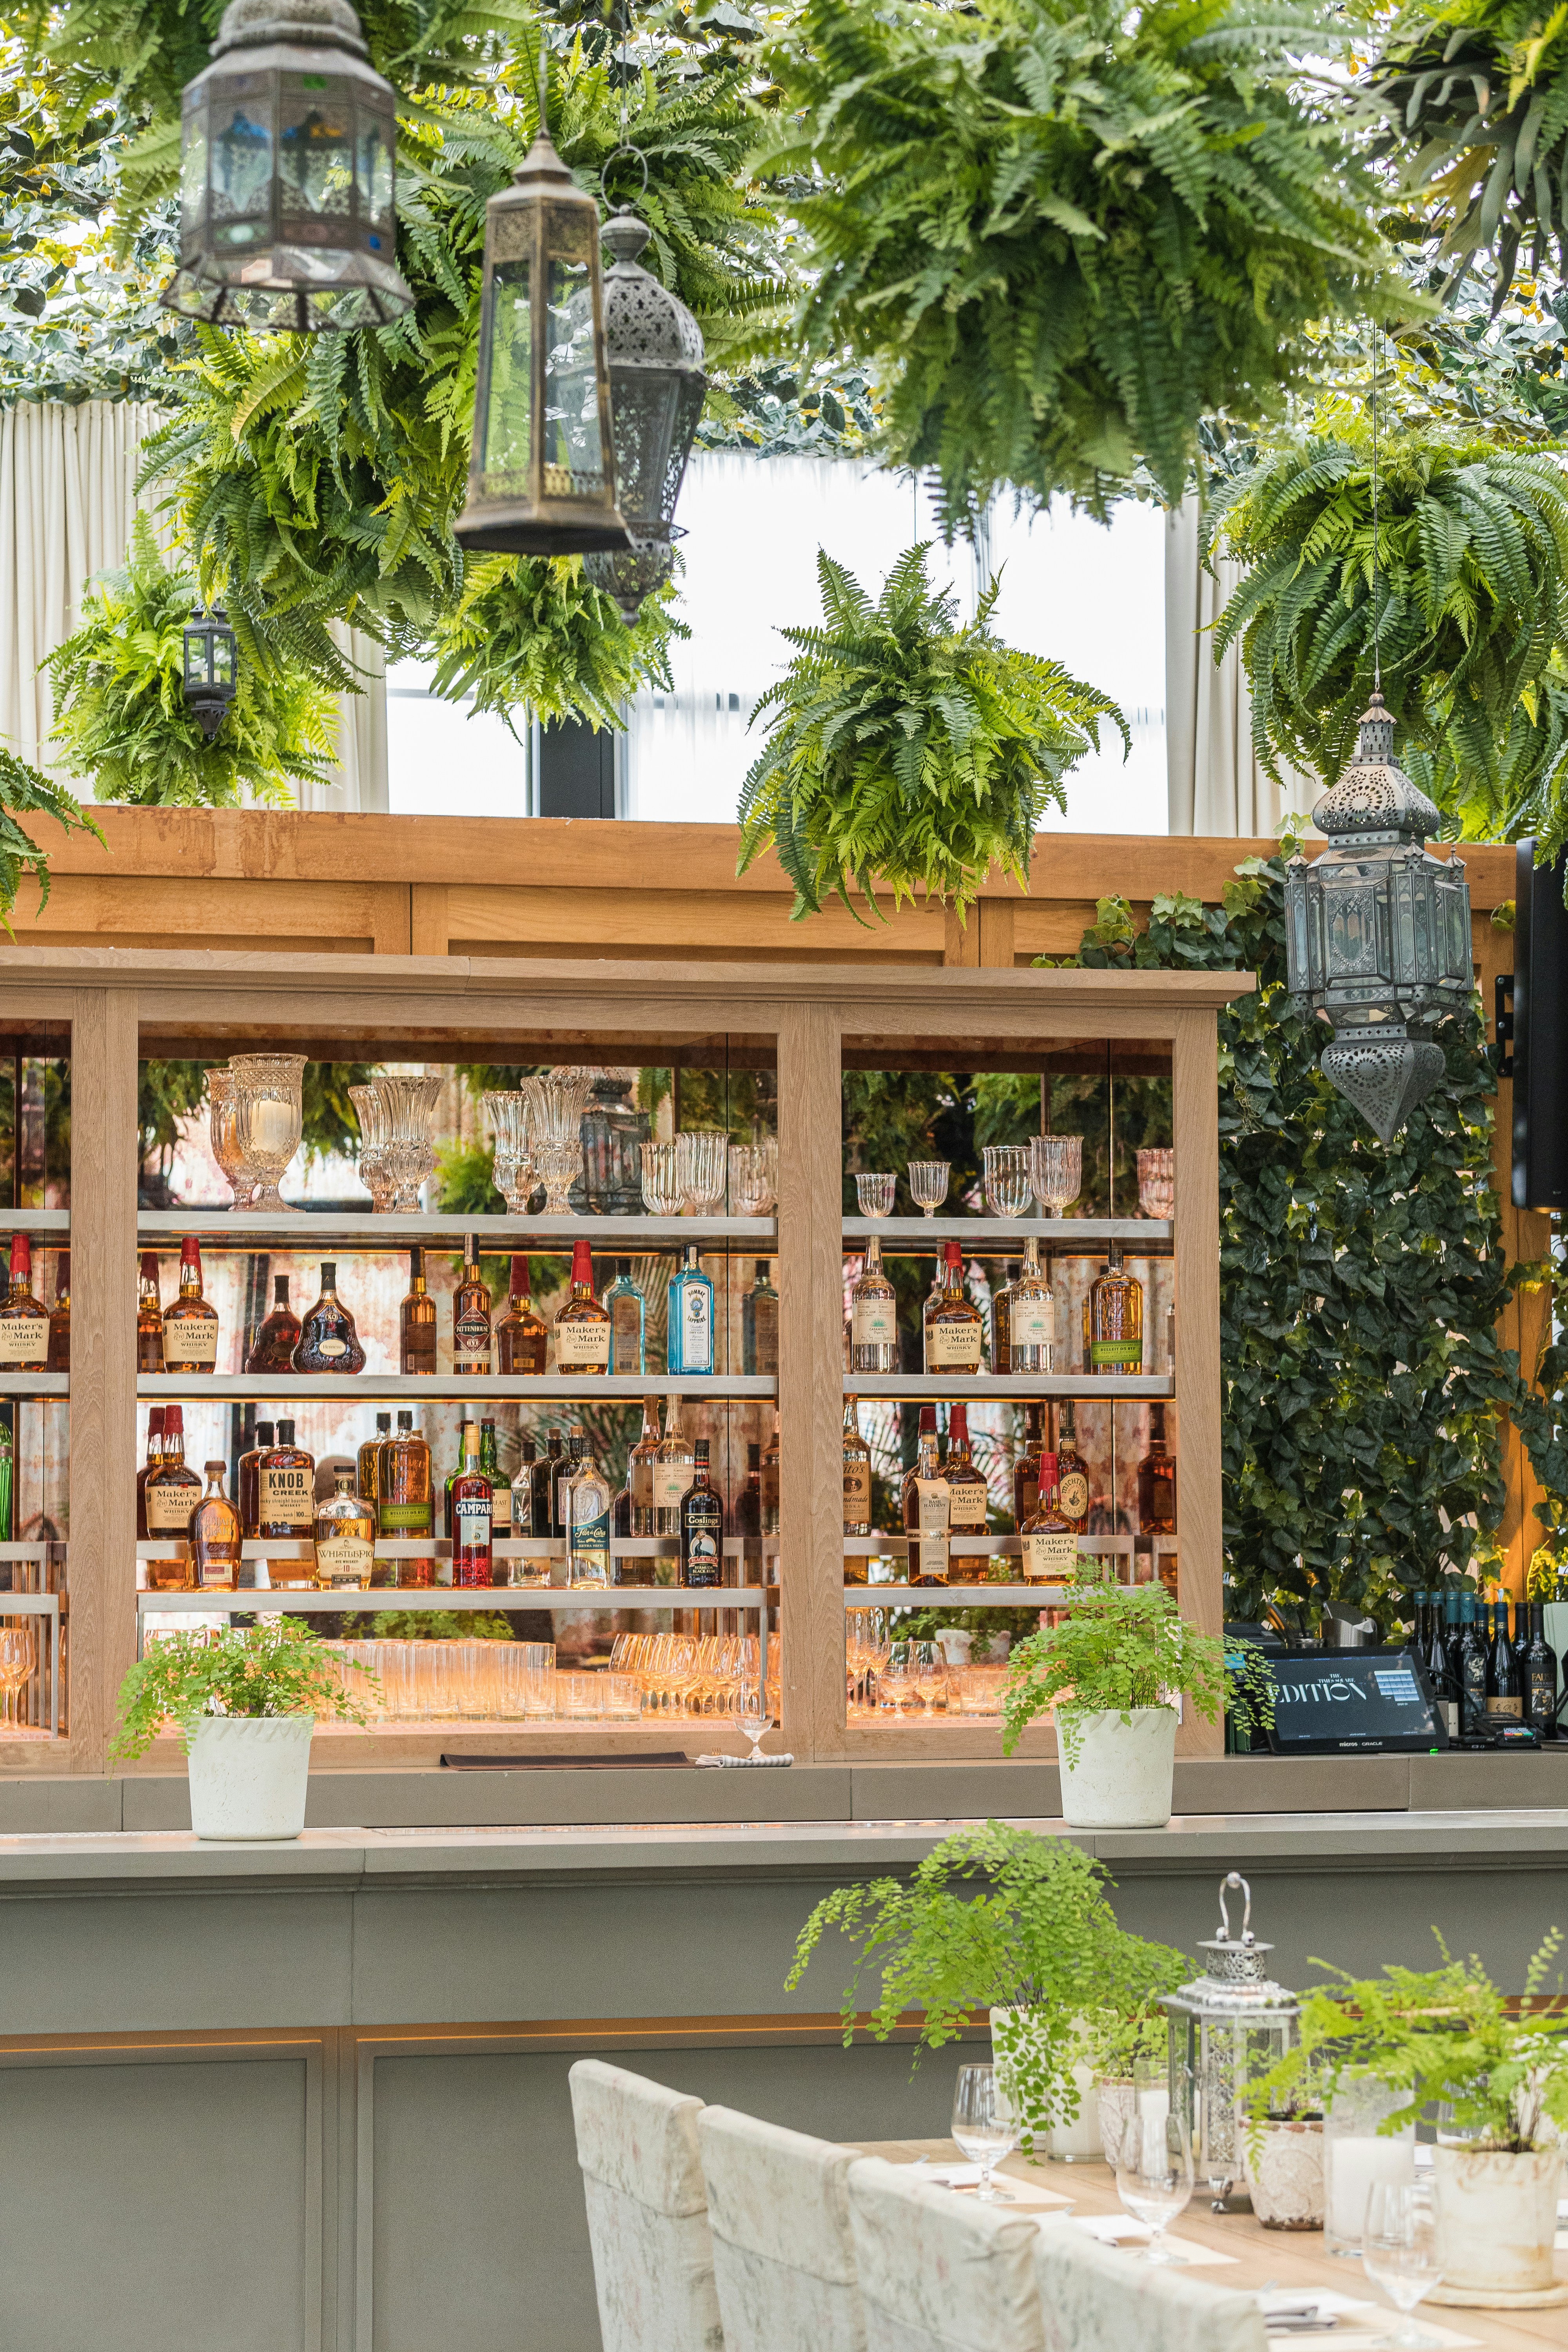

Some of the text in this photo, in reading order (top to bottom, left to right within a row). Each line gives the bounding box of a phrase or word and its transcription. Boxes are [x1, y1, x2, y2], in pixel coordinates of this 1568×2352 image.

[688, 1289, 705, 1298] BOMBAY
[687, 1315, 707, 1323] SAPPHIRE
[269, 1473, 303, 1488] KNOB
[456, 1503, 492, 1515] CAMPARI
[688, 1515, 718, 1526] Goslings
[575, 1527, 590, 1538] Flor
